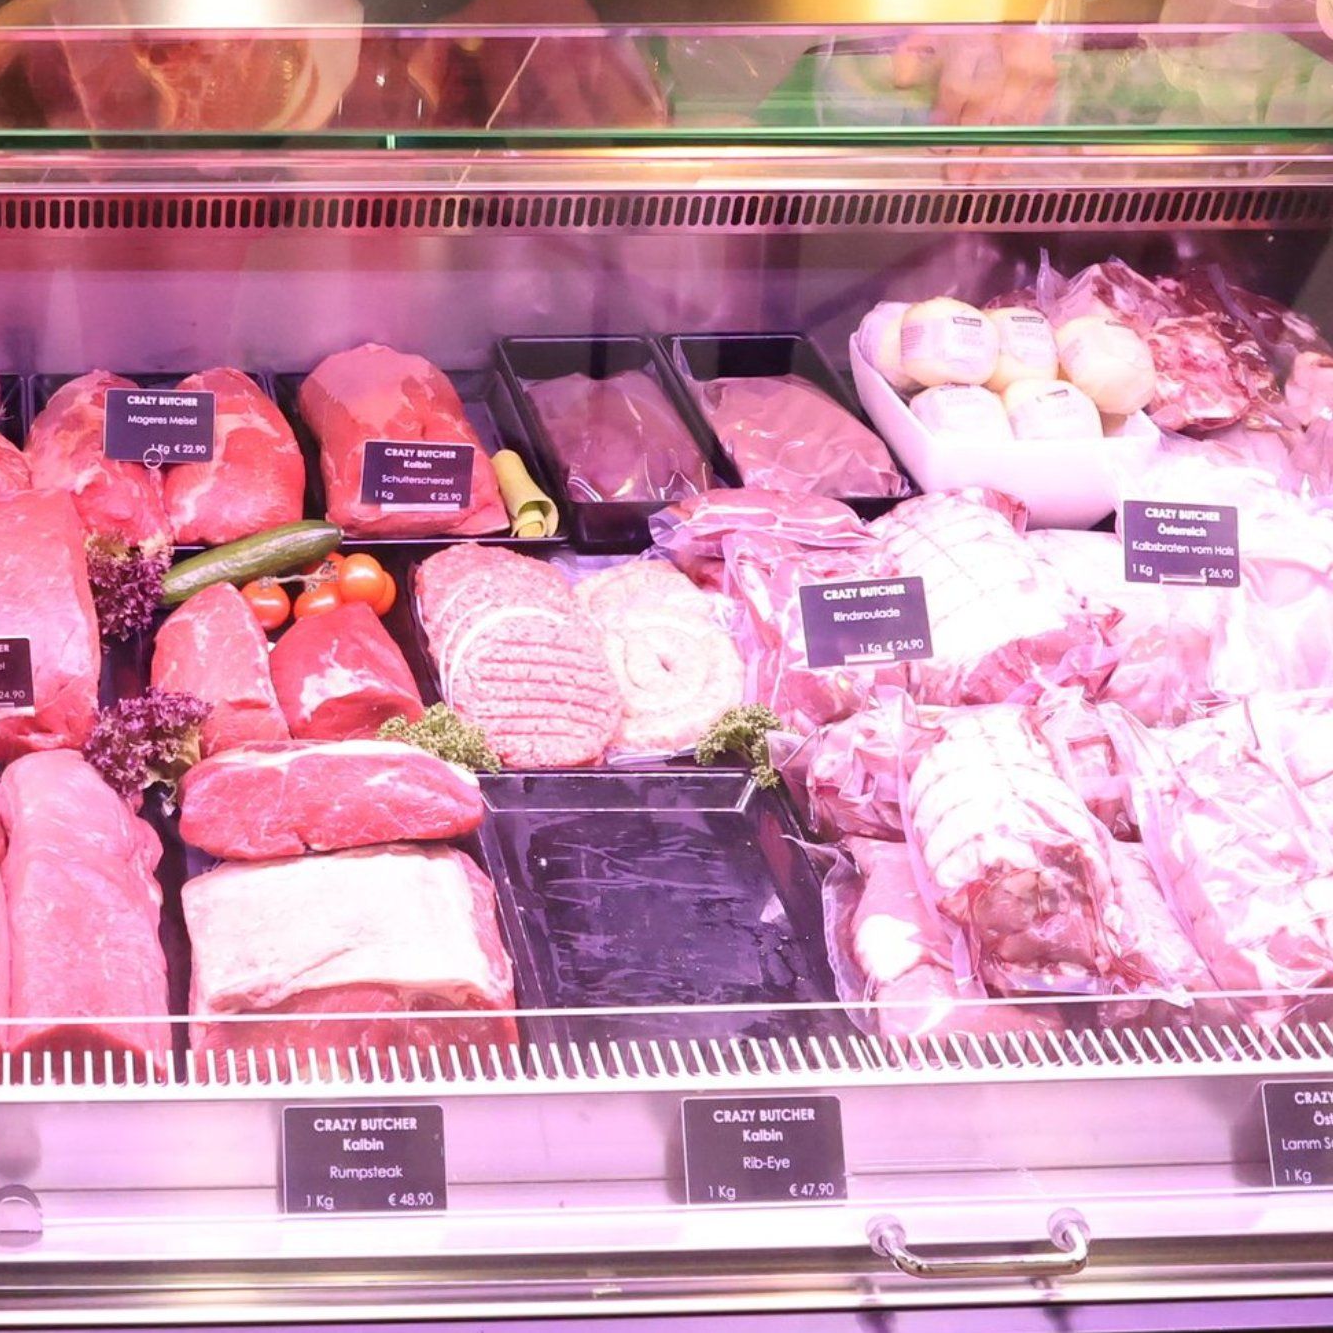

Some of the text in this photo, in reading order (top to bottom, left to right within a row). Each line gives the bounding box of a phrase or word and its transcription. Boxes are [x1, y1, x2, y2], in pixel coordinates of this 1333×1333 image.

[127, 395, 198, 406] CRAZY BUTCHER
[128, 415, 197, 426] Mageres Meisel
[158, 445, 206, 454] Kg € 22.90
[385, 448, 456, 459] CRAZY BUTCHER
[403, 460, 432, 469] Kalbin
[381, 490, 394, 500] Kg
[438, 493, 462, 501] 25.90
[1145, 508, 1221, 522] CRAZY BUTCHER
[1157, 523, 1207, 537] Österreich
[1133, 541, 1234, 556] Kalbsbraten vom Hals
[1132, 564, 1233, 579] 1 Kg 26.90
[823, 584, 905, 600] CRAZY BUTCHER
[833, 608, 901, 622] Rindsroulade
[860, 639, 924, 653] 1 Kg € 24.90
[713, 1108, 815, 1123] CRAZY BUTCHER
[314, 1118, 418, 1132] CRAZY BUTCHER
[742, 1129, 783, 1142] Kalbin
[343, 1138, 384, 1151] Kalbin
[1281, 1138, 1321, 1150] Lamm
[743, 1157, 791, 1171] Rib-Eye
[330, 1166, 403, 1180] Rumpsteak
[1285, 1169, 1312, 1184] 1 Kg
[708, 1183, 834, 1200] 1 Kg € 47.90
[306, 1192, 433, 1209] 1 Kg € 48.90
